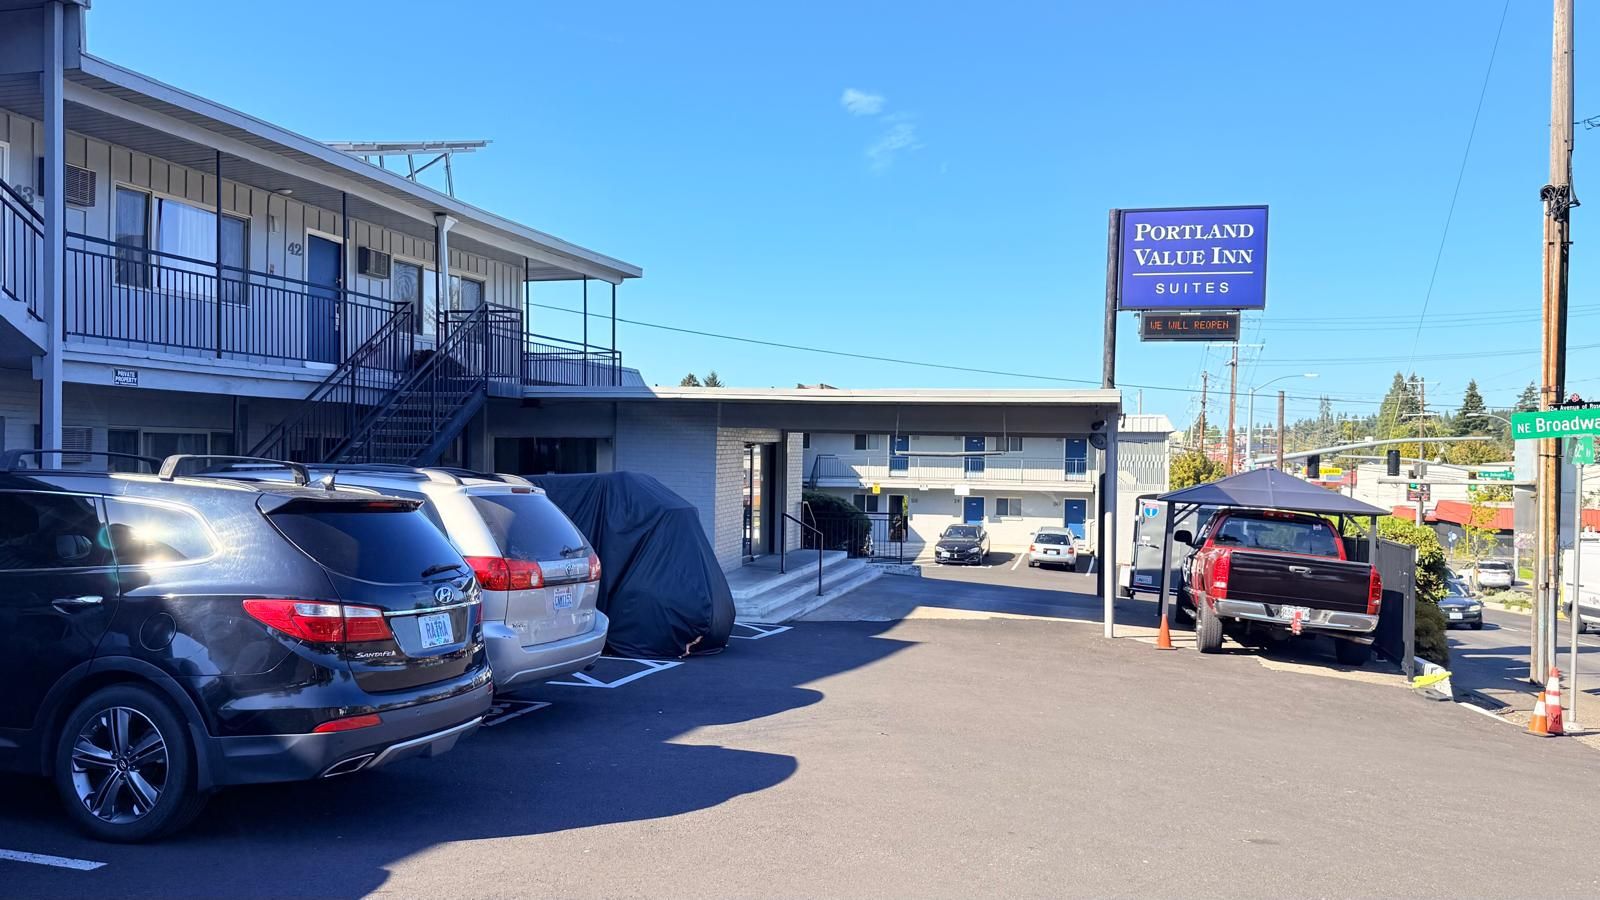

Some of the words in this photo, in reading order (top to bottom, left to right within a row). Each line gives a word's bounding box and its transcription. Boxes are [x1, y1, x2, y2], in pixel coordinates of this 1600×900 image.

[1134, 223, 1254, 241] PORTLAND
[287, 241, 303, 256] 42
[1133, 249, 1205, 266] VALUE
[1211, 247, 1253, 265] INN
[1155, 282, 1230, 294] SUITES
[1150, 321, 1163, 330] WE
[1168, 321, 1189, 330] WILL
[1194, 320, 1229, 330] REOPEN
[1517, 422, 1531, 434] NE
[425, 620, 449, 639] RATRA
